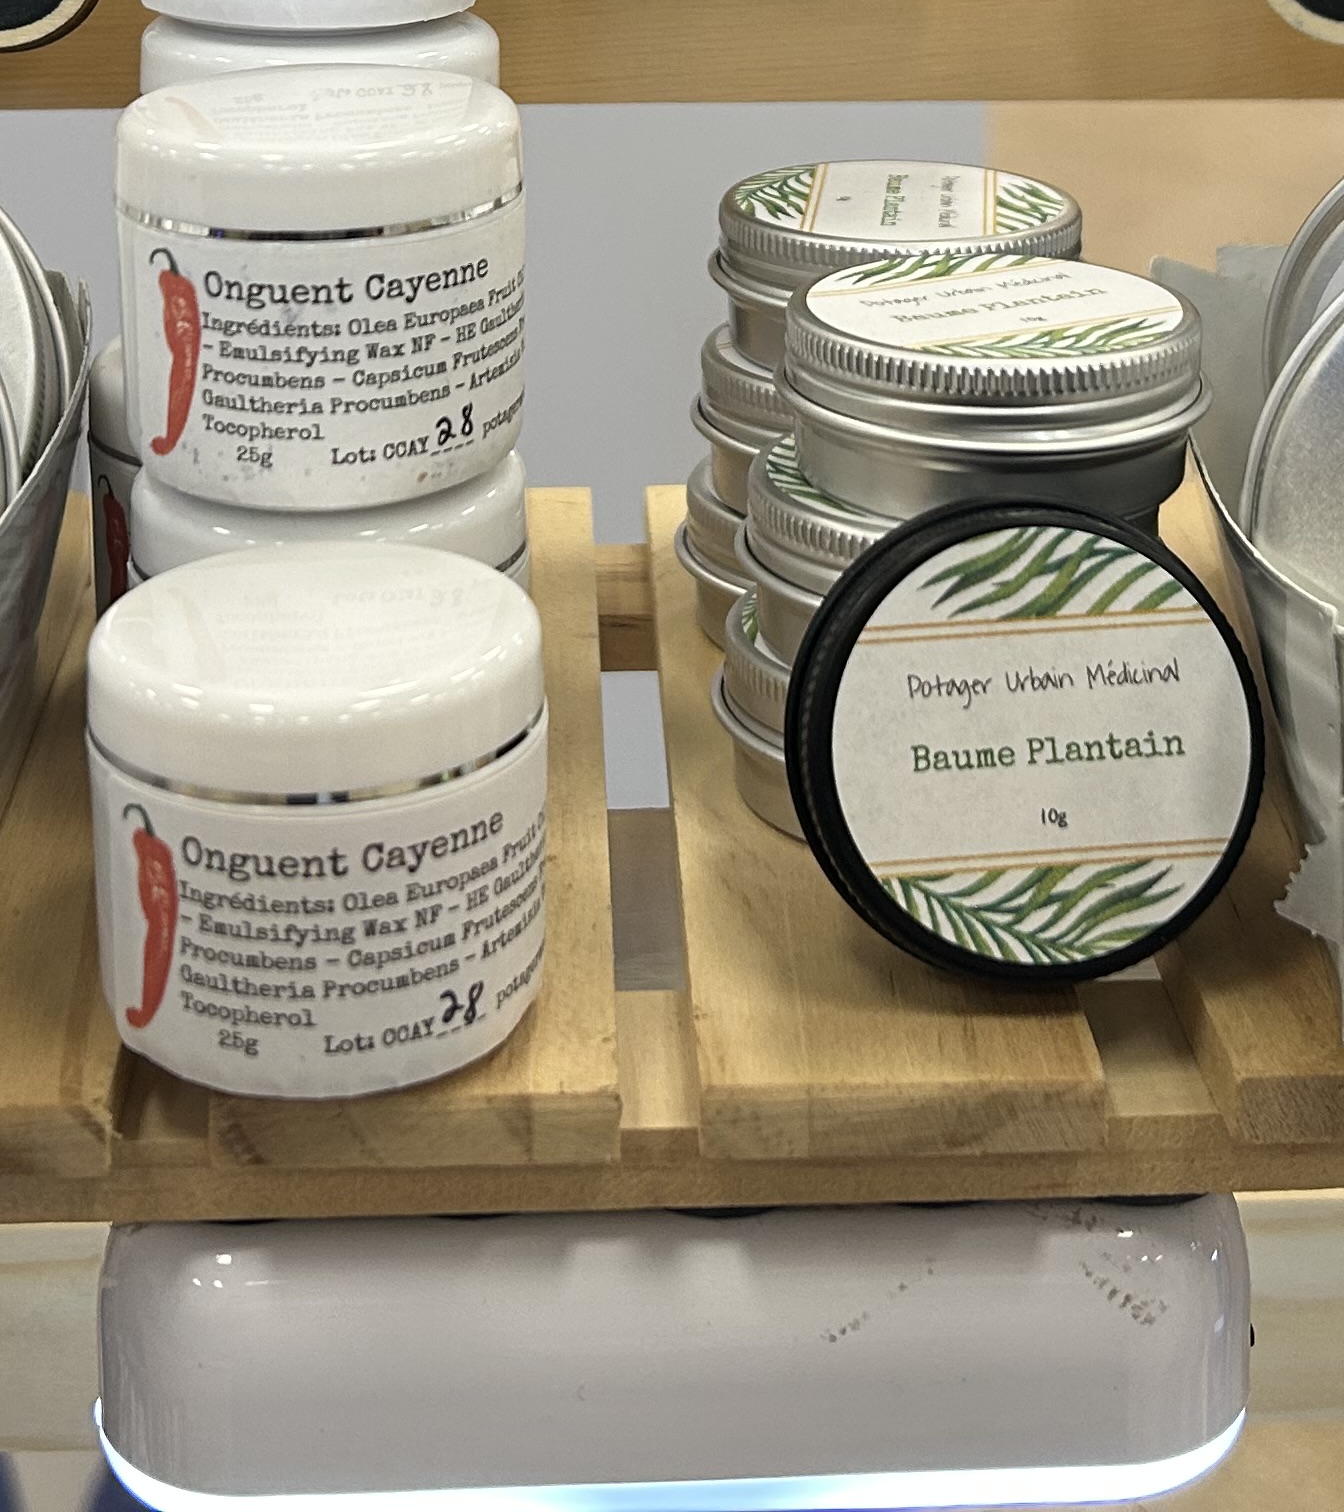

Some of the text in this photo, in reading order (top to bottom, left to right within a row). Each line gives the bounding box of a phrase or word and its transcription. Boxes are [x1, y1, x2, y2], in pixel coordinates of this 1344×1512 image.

[205, 271, 353, 309] Onguent
[365, 258, 488, 302] Cayenne
[980, 288, 1107, 311] Plantain
[202, 312, 340, 337] Ingrédients:
[349, 318, 397, 335] Olea
[404, 298, 484, 330] Europaea
[219, 341, 359, 366] Emulsifying
[365, 342, 404, 360] Wax
[411, 334, 436, 352] NF
[456, 323, 476, 343] HE
[202, 364, 325, 389] Procumbens
[352, 361, 447, 389] Capsicum
[202, 389, 324, 414] Gaultheria
[330, 385, 450, 414] Procumbens
[202, 414, 325, 440] Tocopherol
[236, 446, 273, 467] 25g
[331, 448, 377, 464] Lot:
[908, 658, 1180, 709] Potager Urbain Médicinal
[911, 730, 1186, 773] Baume Plantain
[1041, 807, 1068, 828] 10g
[182, 836, 348, 882] Onguent
[362, 811, 504, 872] Cayenne
[180, 880, 334, 914] Ingrédients:
[343, 893, 398, 911] Olea
[406, 860, 498, 902] Europaea
[198, 914, 355, 945] Emulsifying
[362, 918, 406, 937] Wax
[415, 905, 442, 928] NF
[466, 887, 489, 911] HE
[179, 937, 317, 970] Procumbens
[347, 933, 455, 968] Capsicum
[181, 965, 315, 998] Gaultheria
[322, 957, 460, 996] Procumbens
[180, 991, 317, 1026] Tocopherol
[219, 1029, 259, 1055] 25g
[324, 1035, 375, 1053] Lot:
